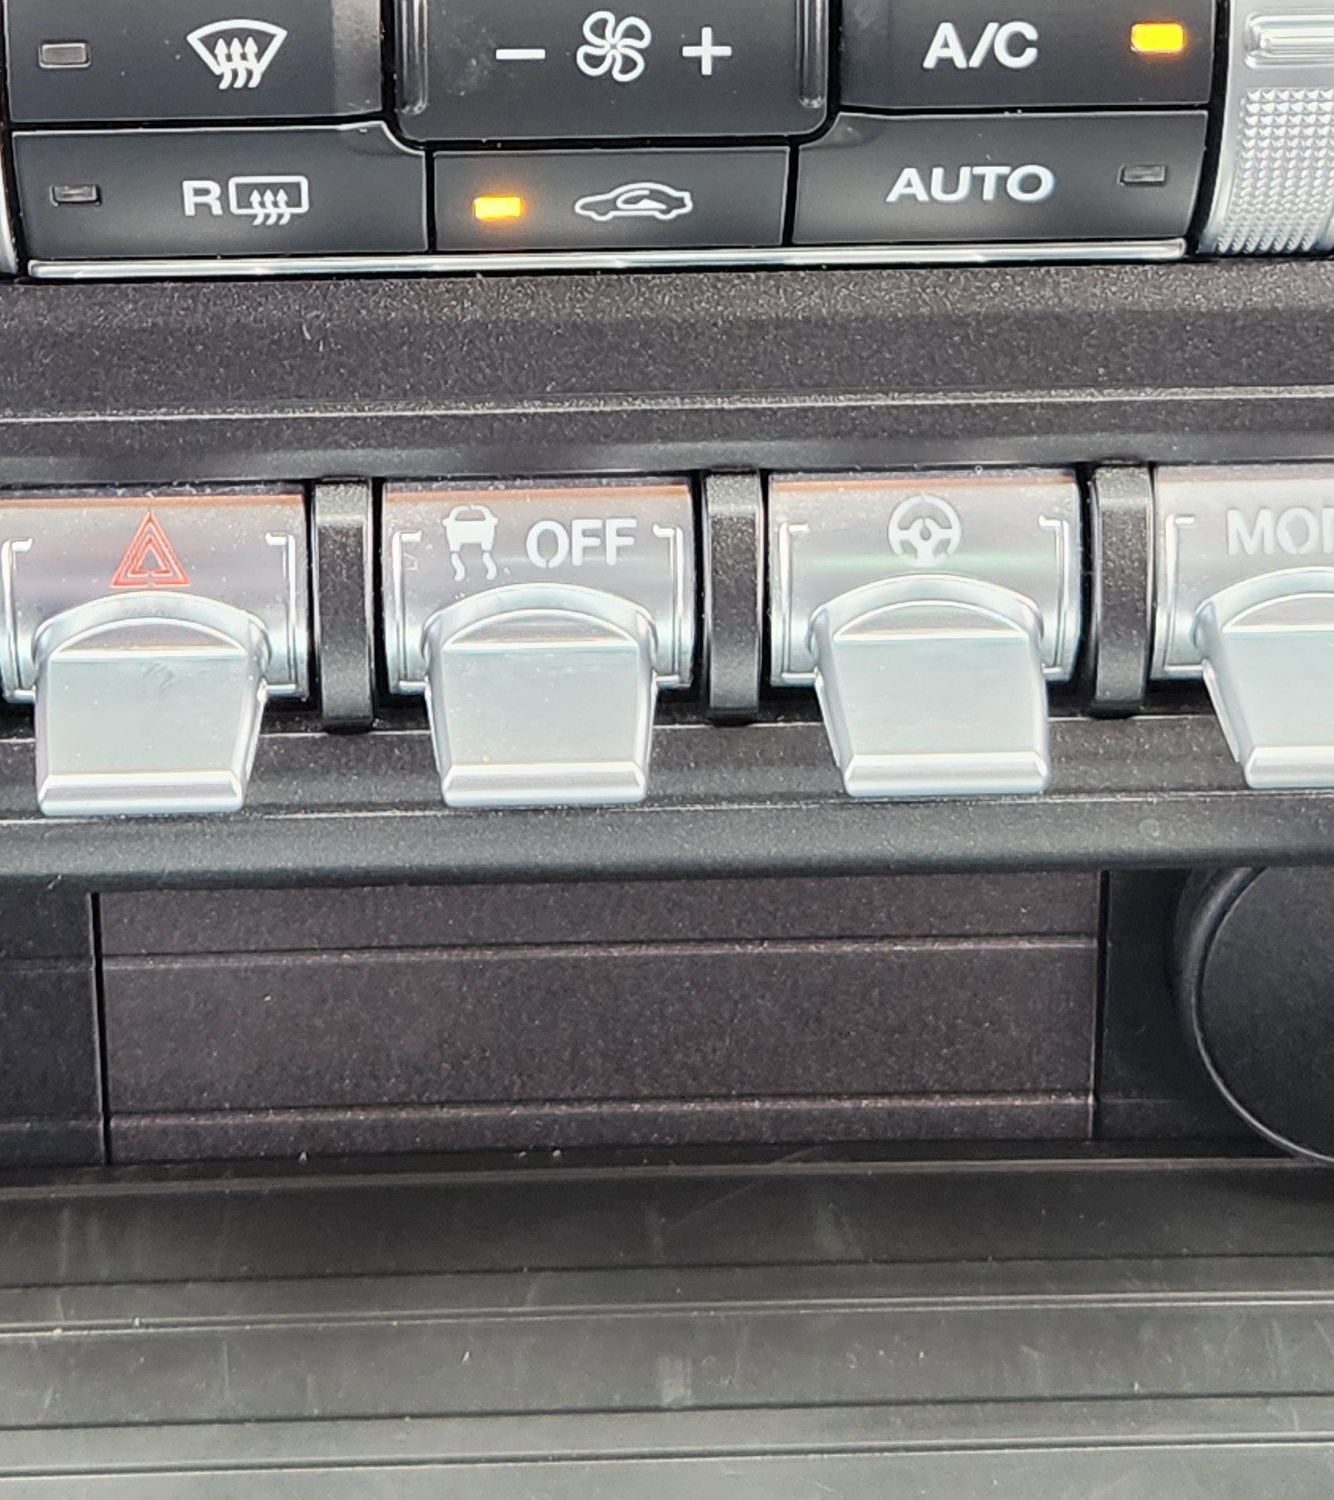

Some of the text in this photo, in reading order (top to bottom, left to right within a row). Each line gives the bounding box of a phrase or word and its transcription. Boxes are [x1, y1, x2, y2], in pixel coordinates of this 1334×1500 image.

[923, 21, 1040, 70] A/C
[183, 180, 224, 216] R
[886, 163, 1055, 203] AUTO
[524, 517, 638, 568] OFF
